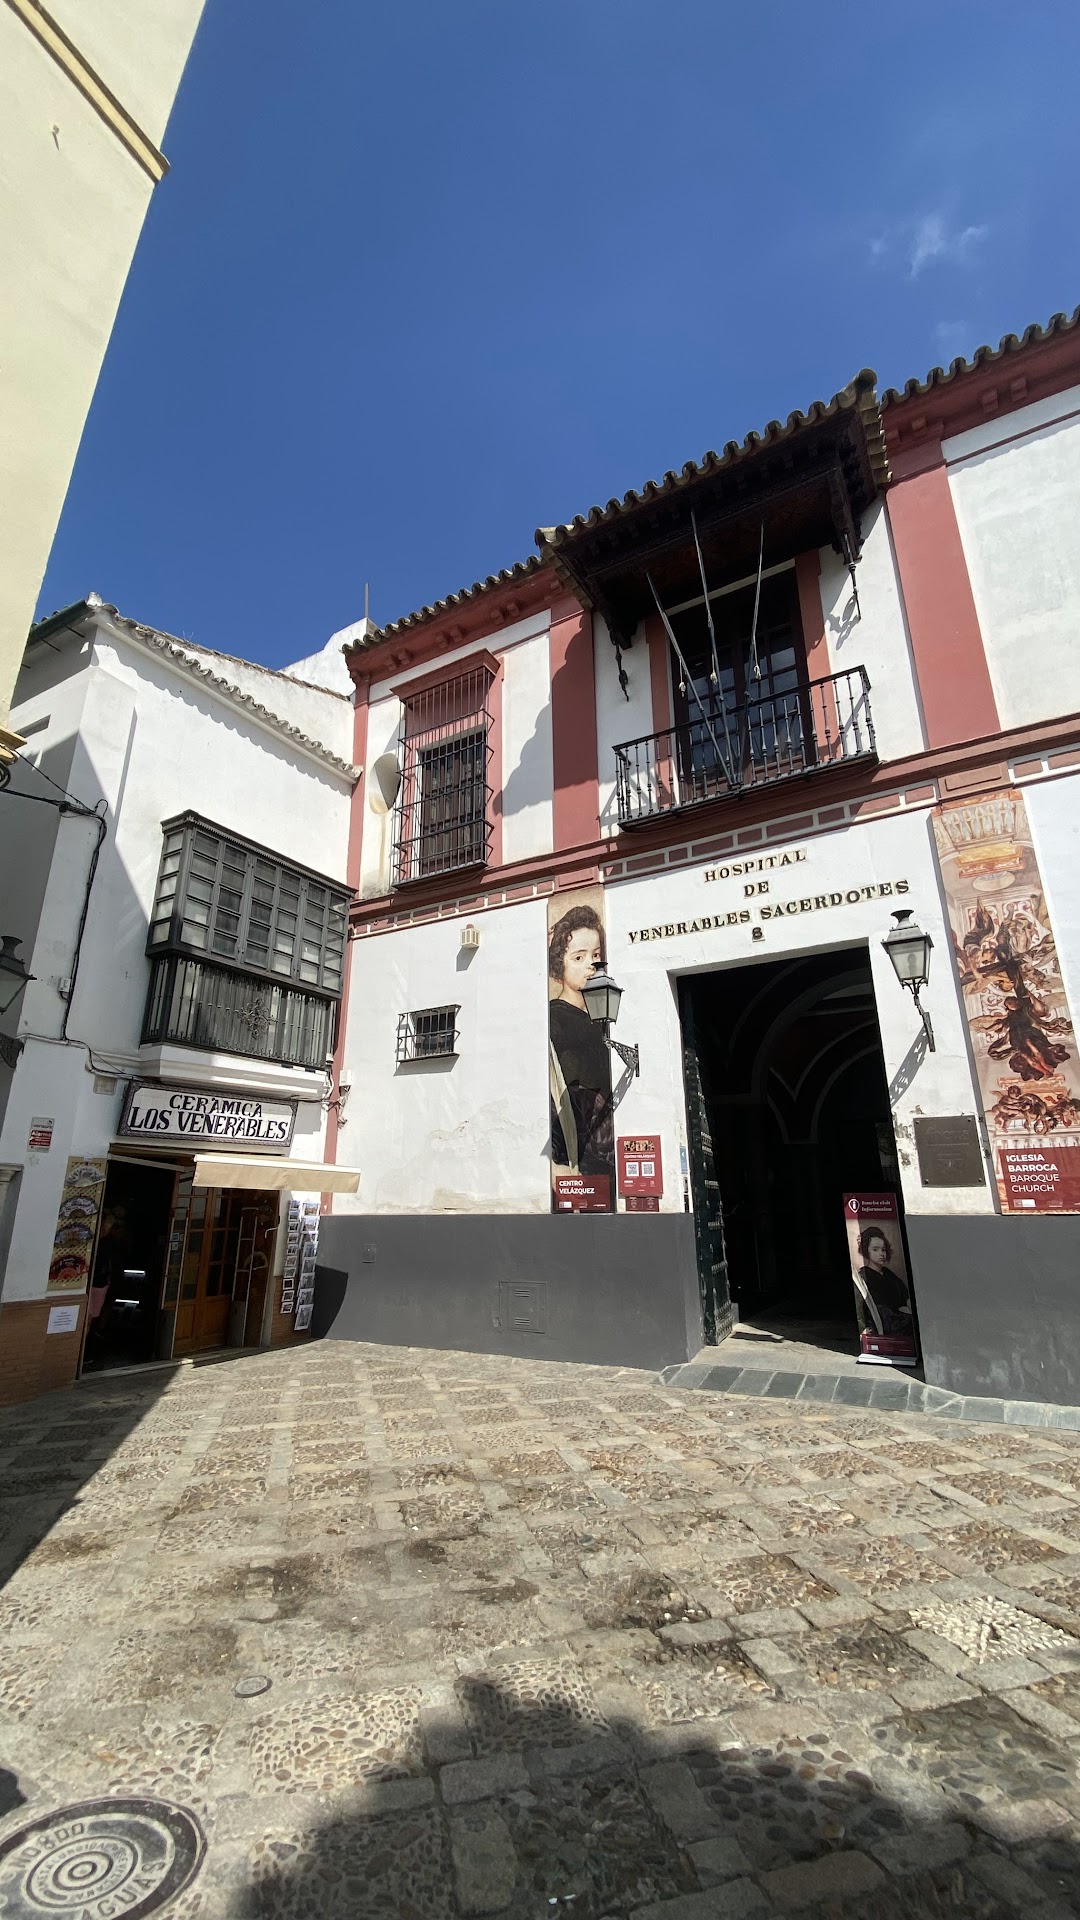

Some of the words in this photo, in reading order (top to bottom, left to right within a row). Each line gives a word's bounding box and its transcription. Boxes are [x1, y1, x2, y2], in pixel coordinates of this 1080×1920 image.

[704, 850, 807, 883] HOSPITAL
[743, 881, 770, 898] DE
[628, 910, 751, 943] VENERABLES
[761, 879, 911, 921] SACERDOTES
[751, 927, 764, 940] 8
[130, 1106, 172, 1130] LOS
[178, 1111, 289, 1139] VENERABLES
[1006, 1153, 1045, 1162] IGLESIA
[1008, 1163, 1058, 1172] BARROCA
[1010, 1173, 1061, 1183] BAROQUE
[558, 1187, 595, 1195] VELÁZQUEZ
[1011, 1184, 1055, 1193] CHURCH
